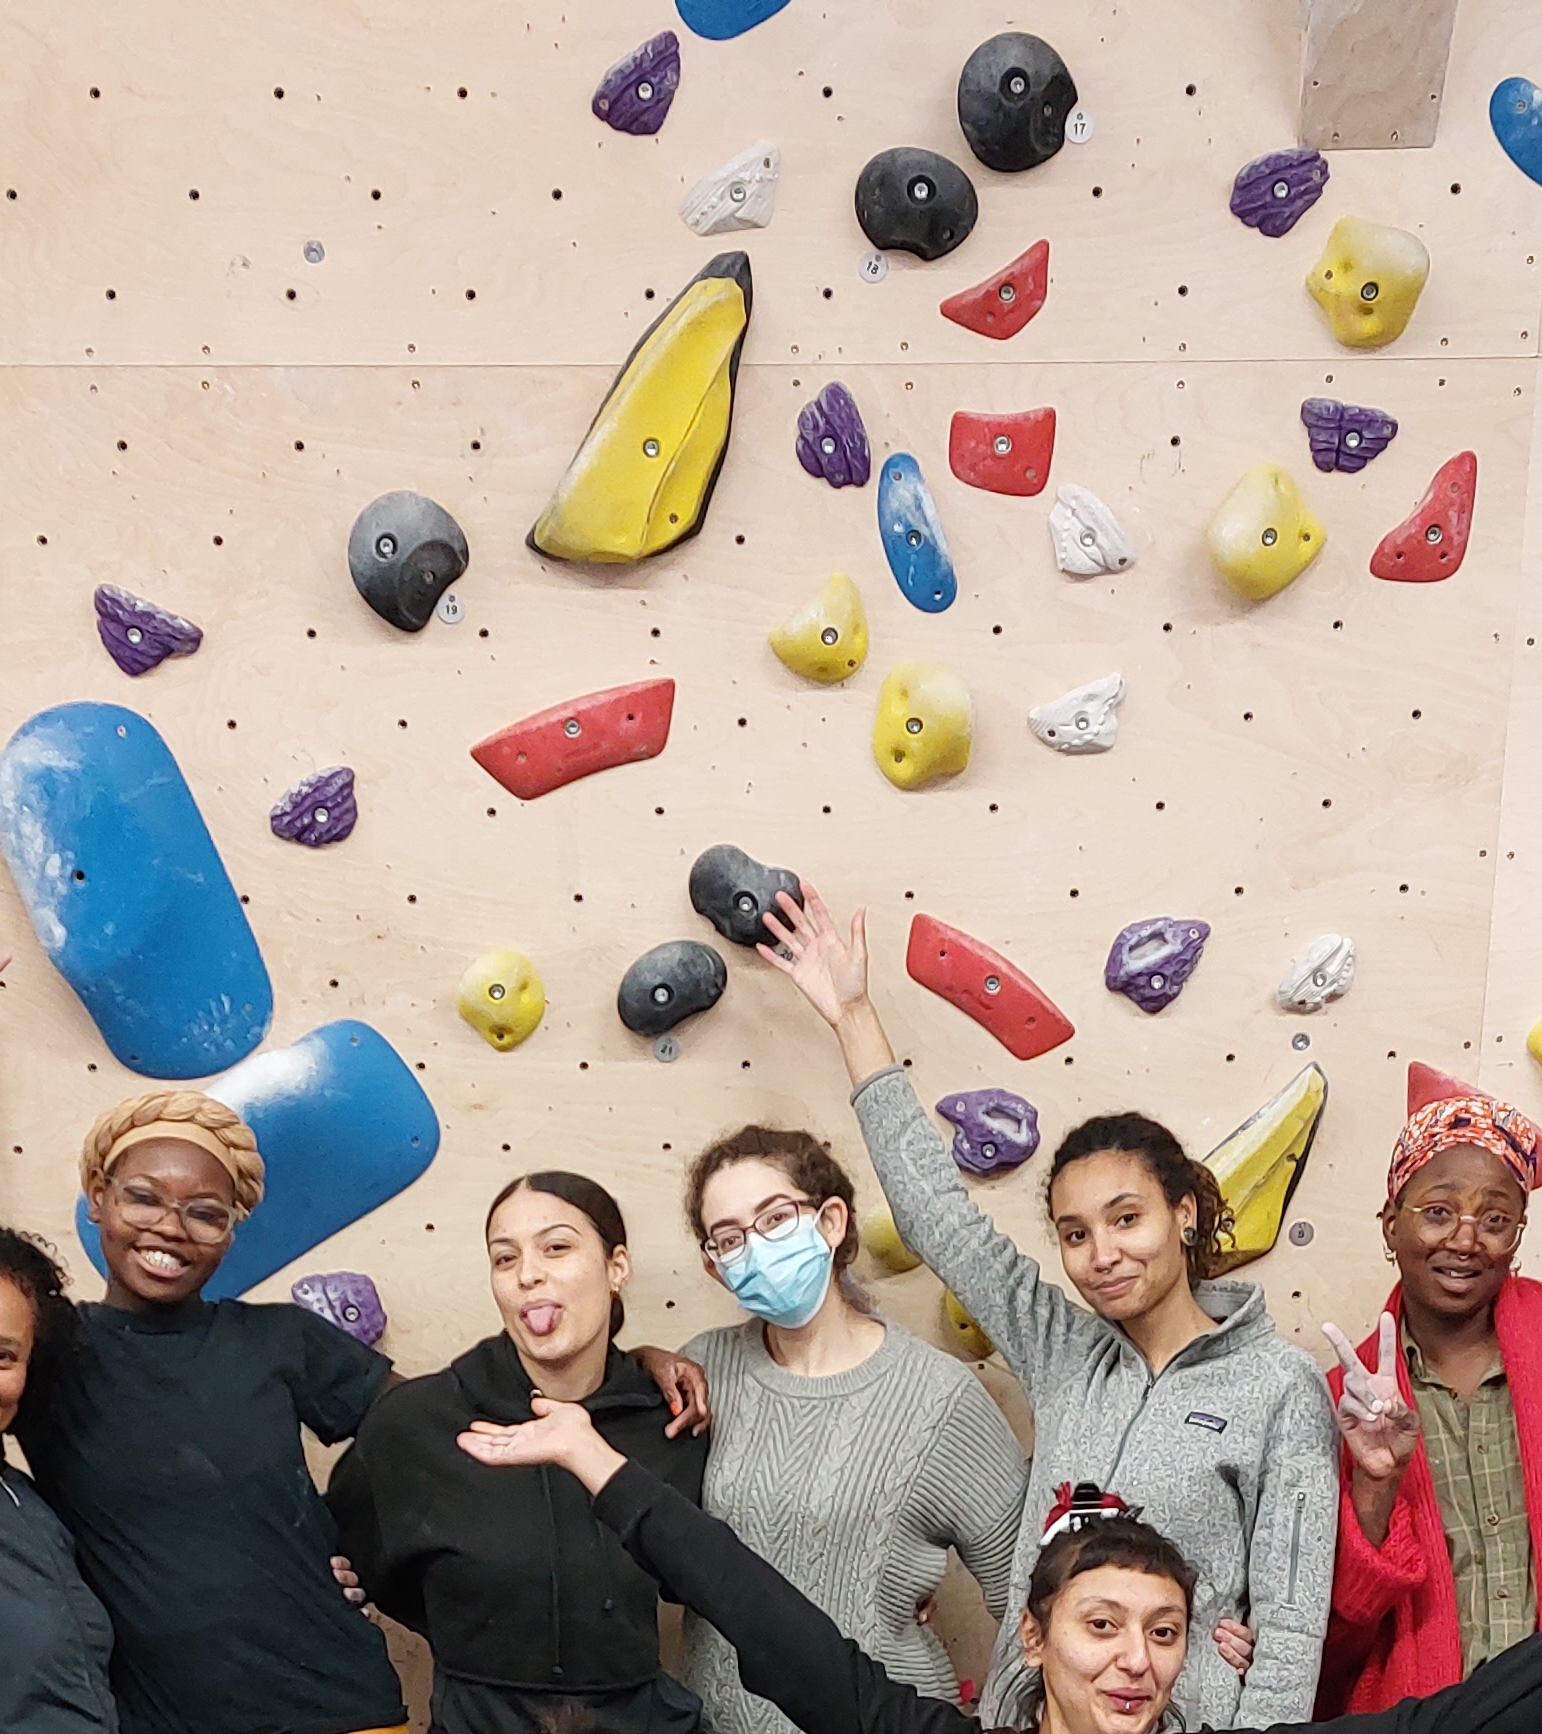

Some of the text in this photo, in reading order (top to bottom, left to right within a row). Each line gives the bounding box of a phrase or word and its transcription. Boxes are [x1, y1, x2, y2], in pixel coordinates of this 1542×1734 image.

[1073, 122, 1087, 136] 17
[866, 260, 880, 275] 18
[445, 604, 458, 615] 19
